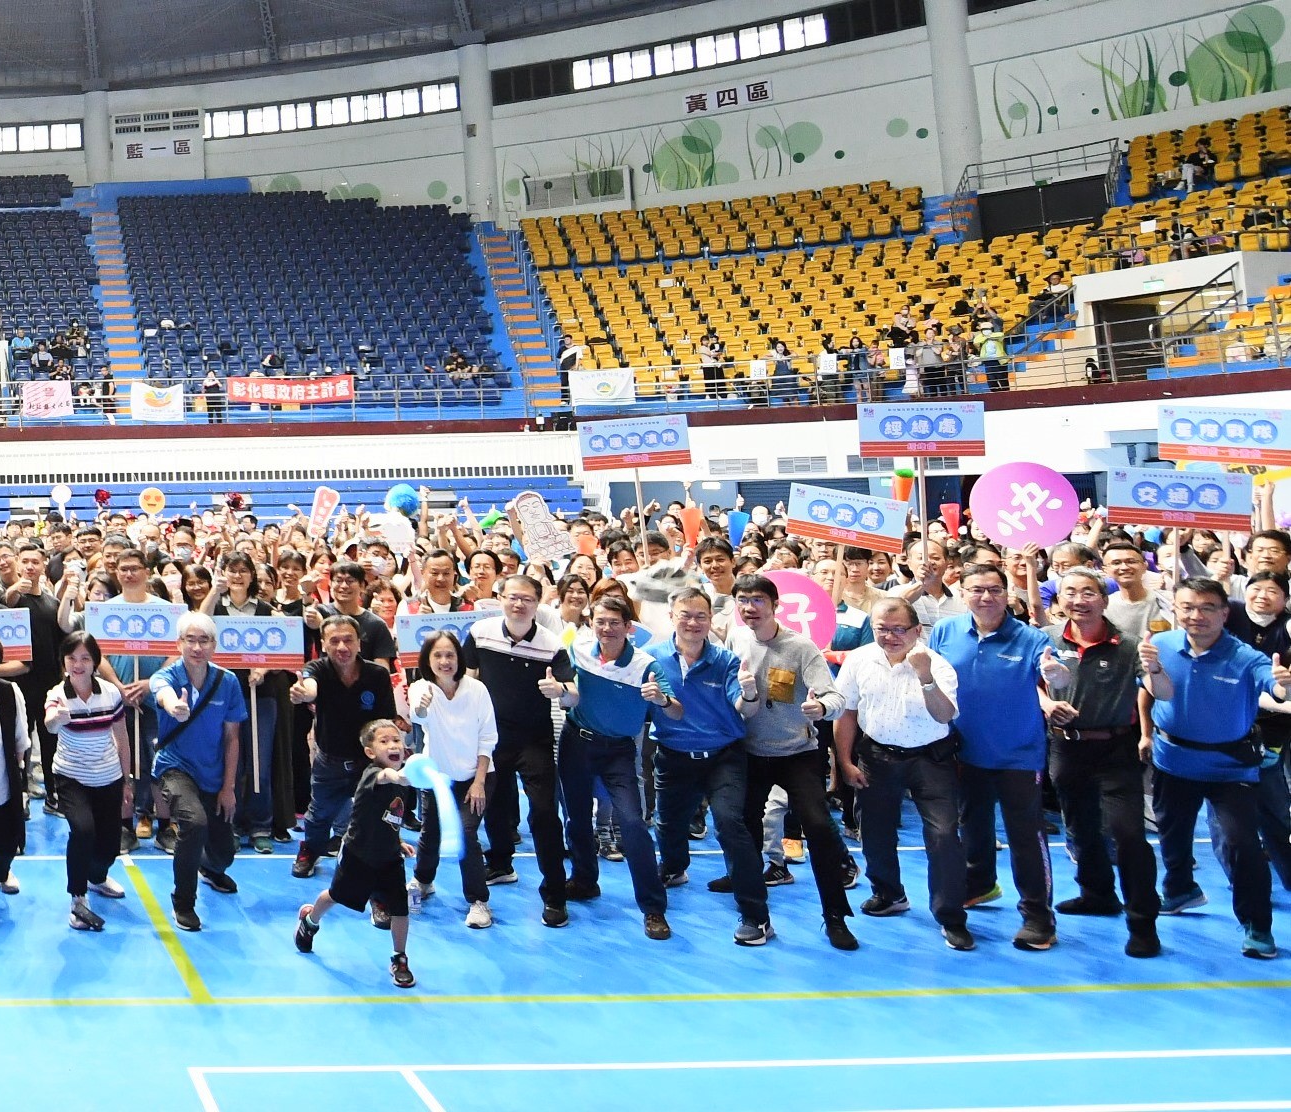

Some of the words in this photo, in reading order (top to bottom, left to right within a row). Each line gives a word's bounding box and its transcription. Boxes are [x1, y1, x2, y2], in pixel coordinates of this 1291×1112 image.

[685, 81, 770, 113] 黃四區
[126, 139, 191, 159] 藍一區
[232, 380, 349, 400] 彰化縣政府主計處
[1137, 486, 1220, 506] 交通處
[811, 505, 879, 528] 地政處
[996, 482, 1063, 536] 快
